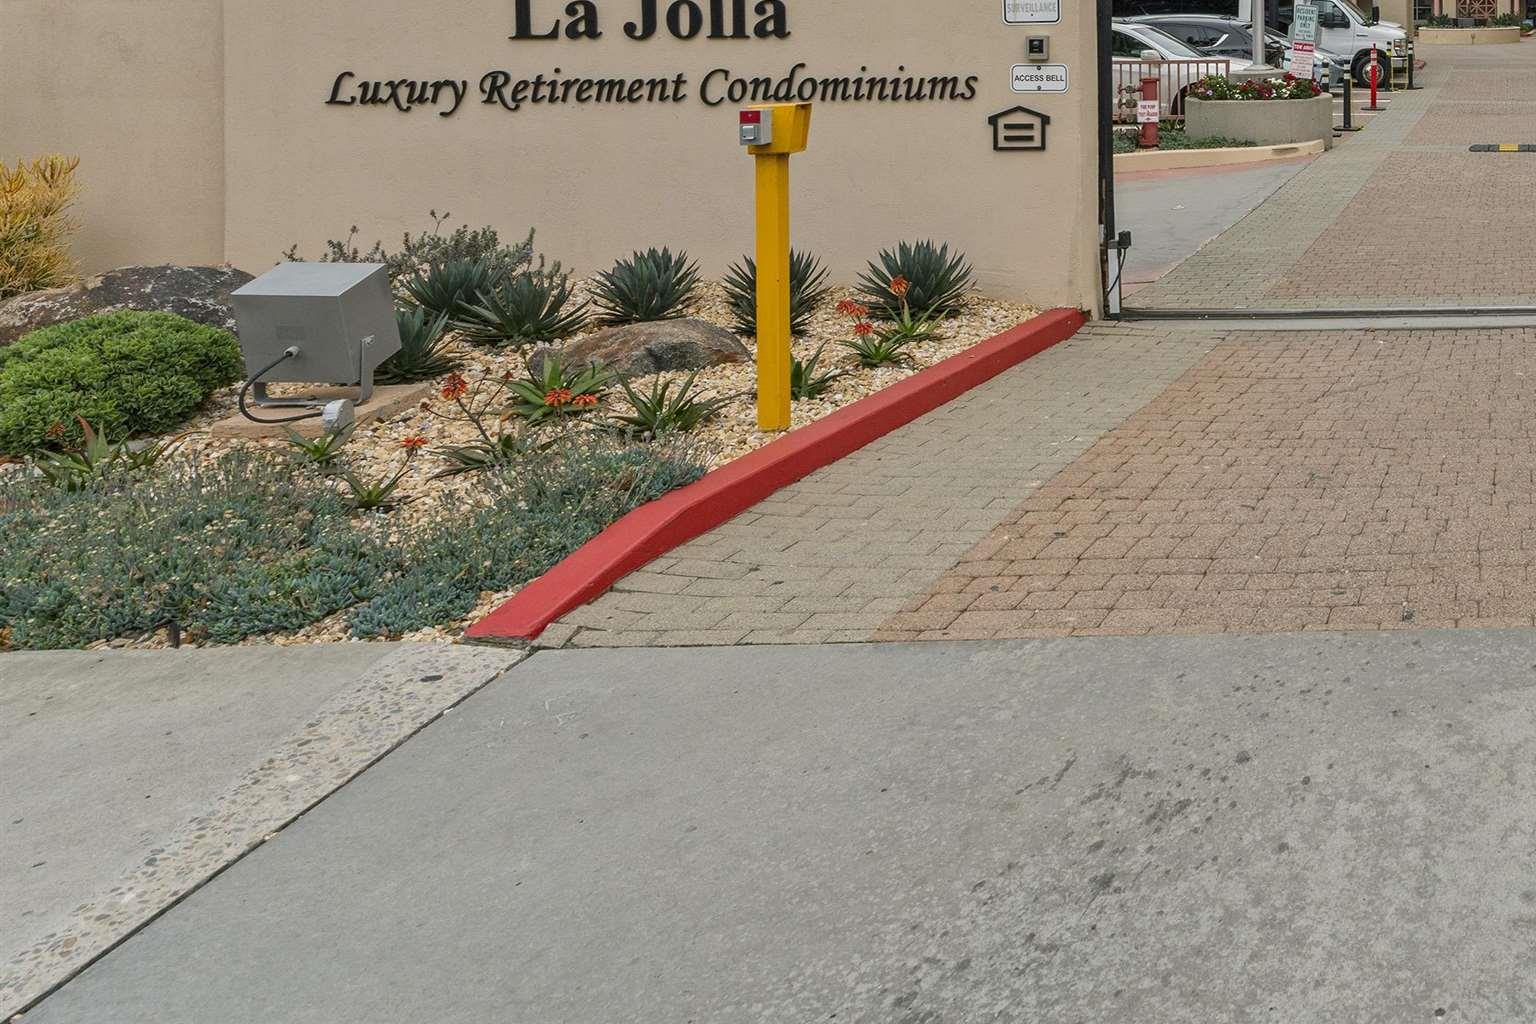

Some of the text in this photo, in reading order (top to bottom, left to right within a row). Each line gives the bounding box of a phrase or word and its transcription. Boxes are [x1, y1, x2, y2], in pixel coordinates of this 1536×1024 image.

[1007, 2, 1057, 14] SURVEILLANCE
[1014, 74, 1065, 82] ACCESS BELL
[325, 63, 980, 116] Luxury Retirement Condominiums
